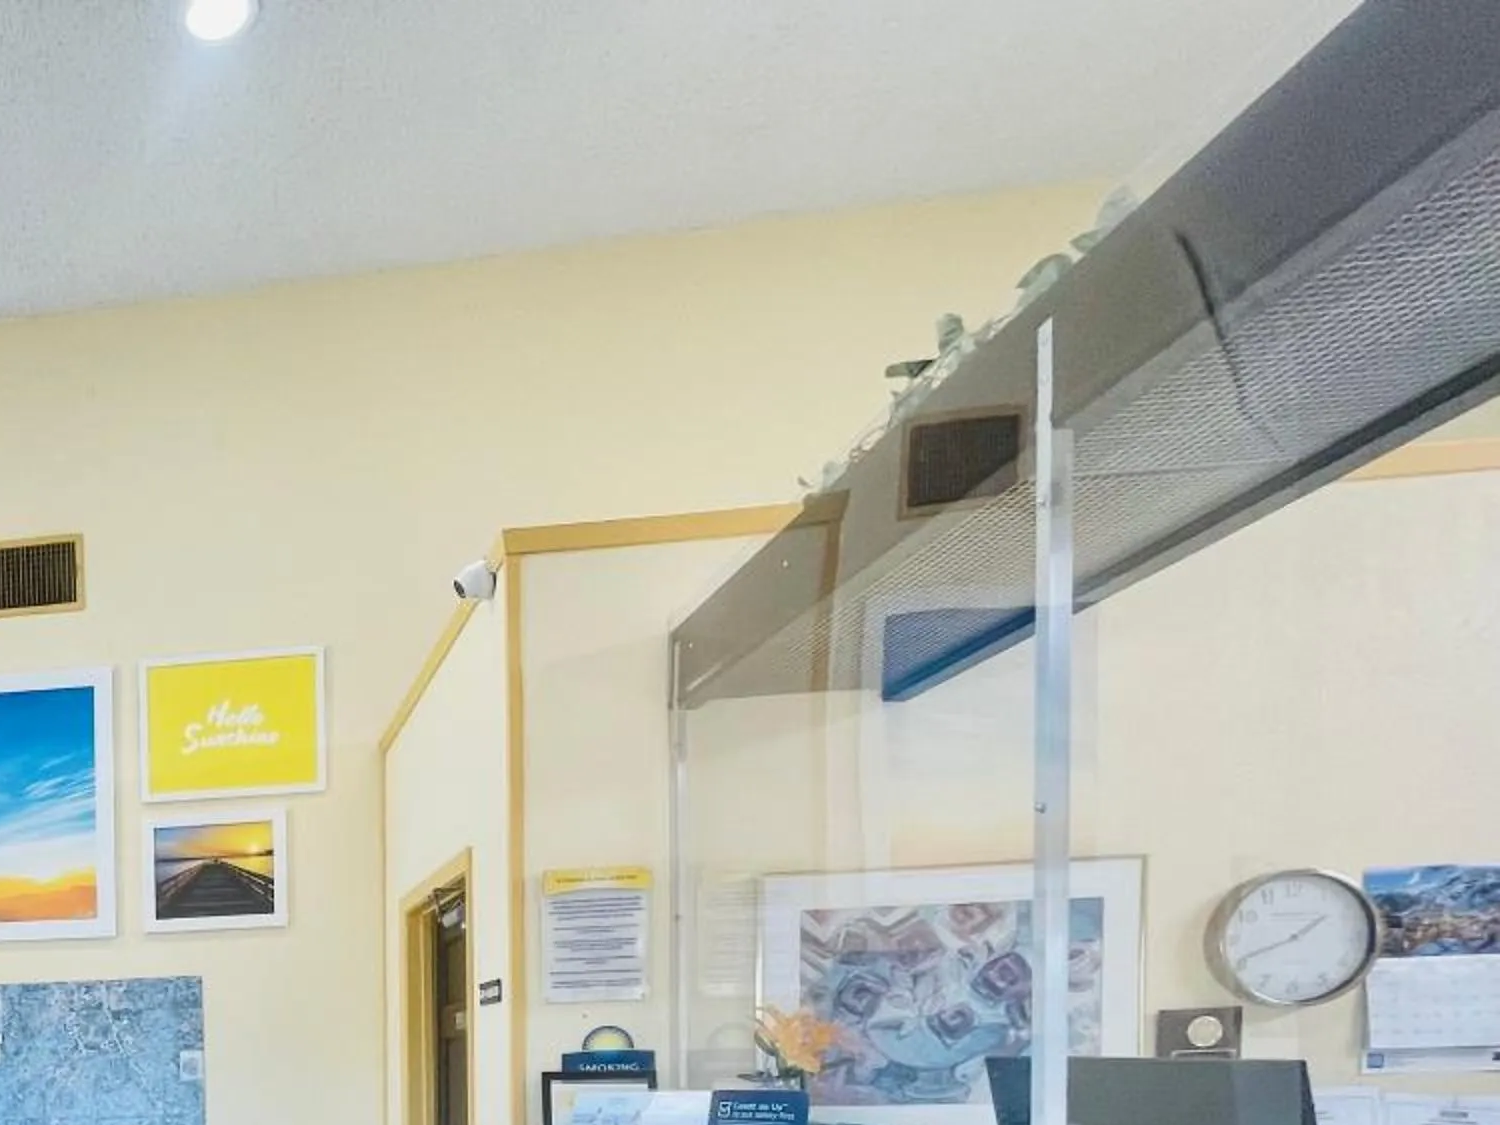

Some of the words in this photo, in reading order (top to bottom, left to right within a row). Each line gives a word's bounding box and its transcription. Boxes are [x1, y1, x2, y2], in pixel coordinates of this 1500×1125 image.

[208, 699, 264, 726] Hello
[182, 723, 280, 755] Sunshine
[1261, 888, 1275, 905] 11
[1238, 909, 1258, 925] 10
